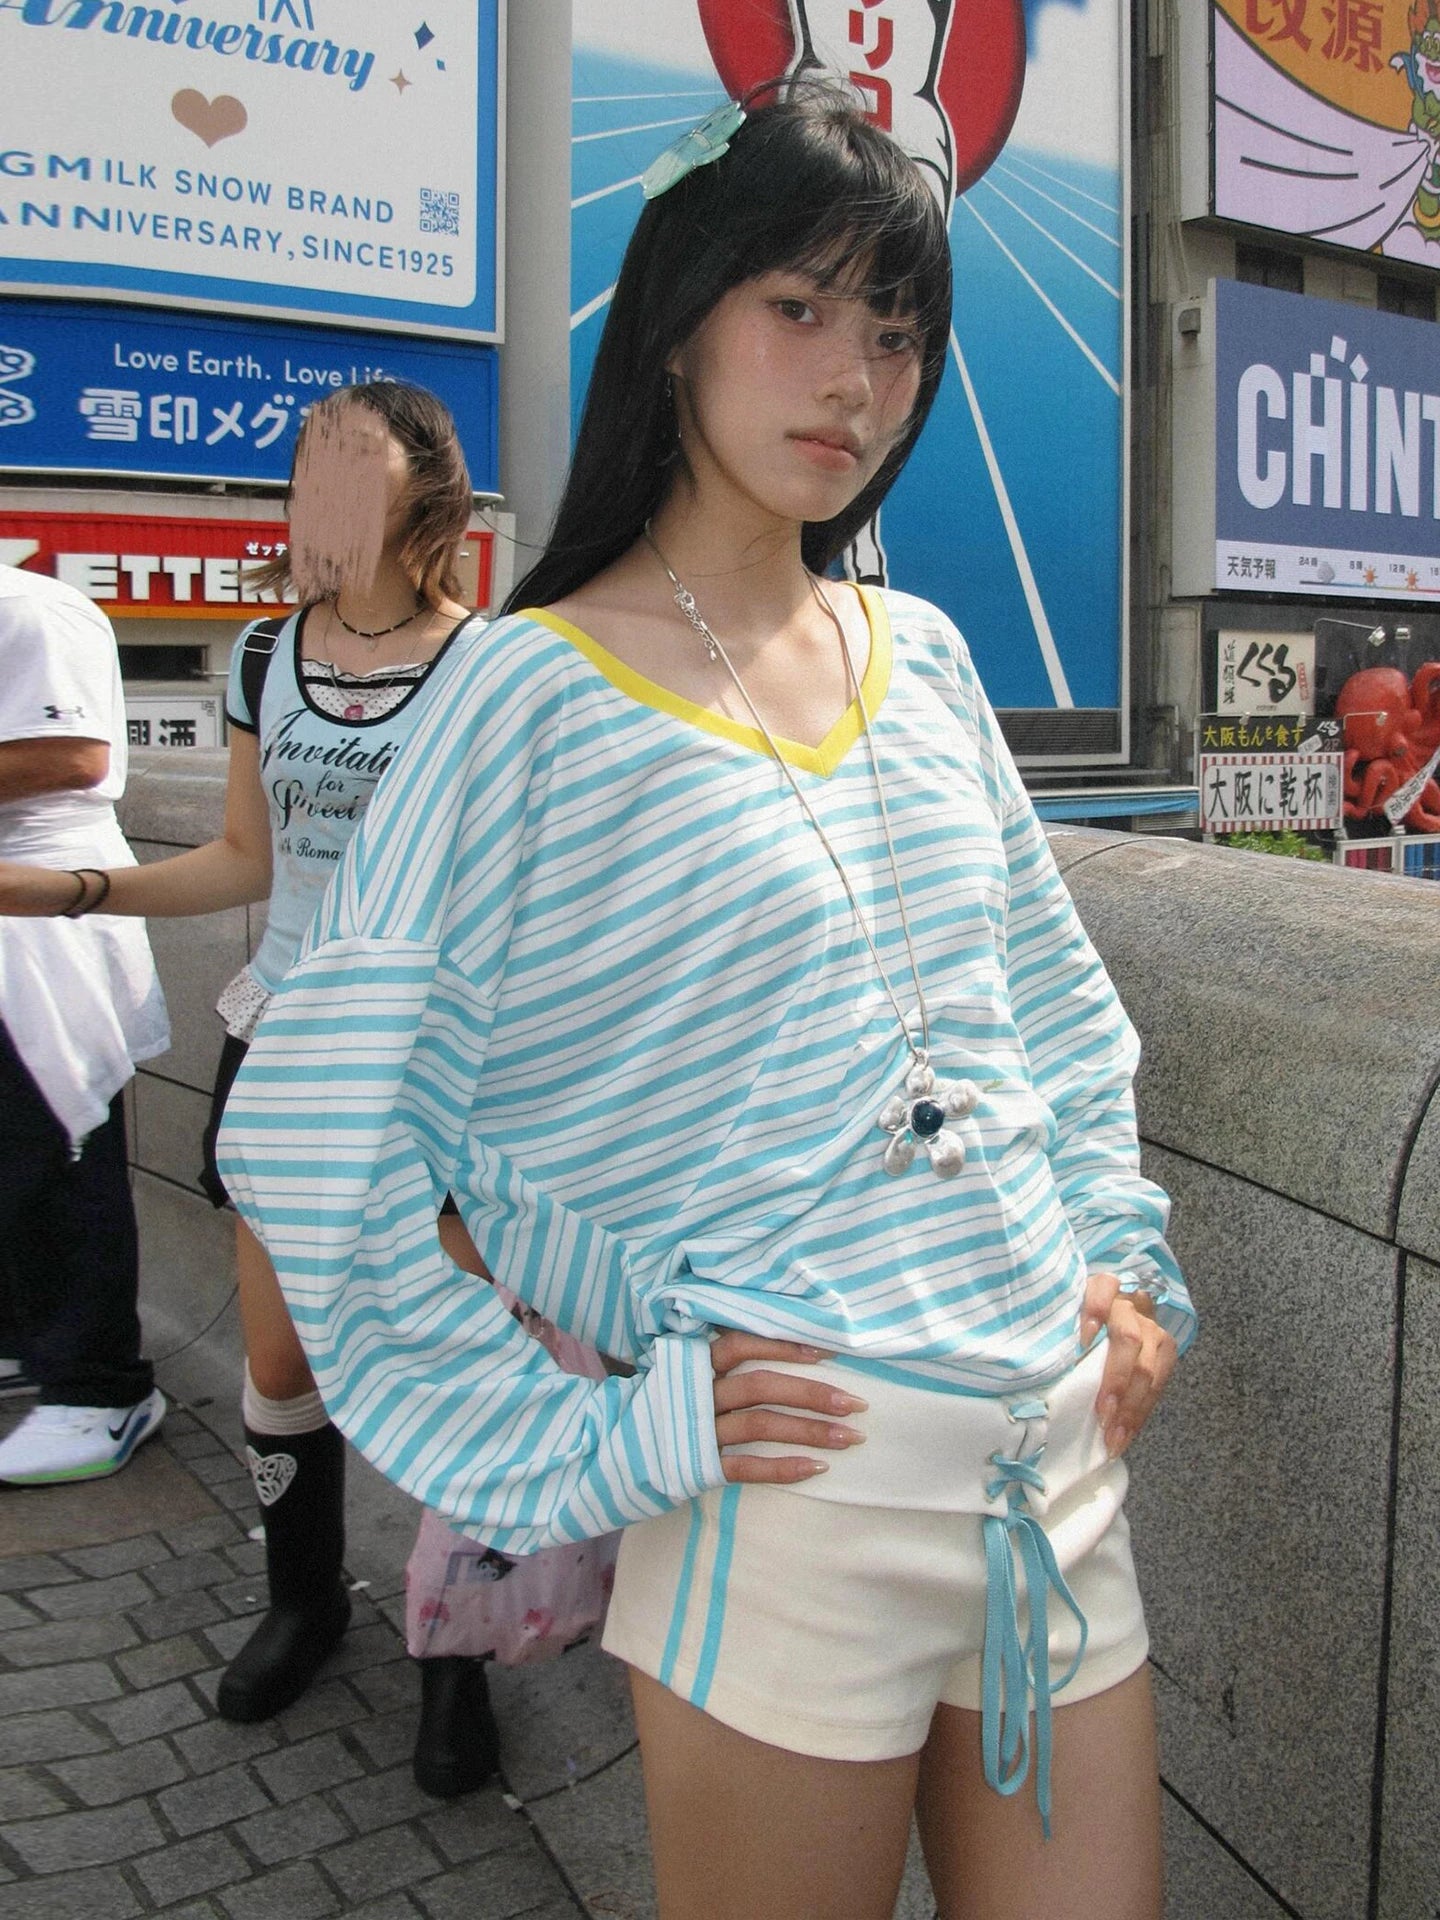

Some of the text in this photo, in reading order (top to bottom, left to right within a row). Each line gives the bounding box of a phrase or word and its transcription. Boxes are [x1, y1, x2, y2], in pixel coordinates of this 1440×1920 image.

[175, 169, 272, 206] SNOW
[287, 186, 395, 224] BRAND
[115, 343, 178, 372] Love
[187, 351, 272, 381] Earth.
[284, 360, 343, 387] Love
[79, 387, 311, 450] 雪印メグ
[1227, 555, 1276, 579] 天気予報
[1237, 642, 1297, 703] くくる
[1203, 723, 1304, 748] 大阪もんを食す
[272, 779, 359, 831] Sweet
[314, 769, 346, 798] for
[1209, 766, 1322, 819] 大阪に乾杯
